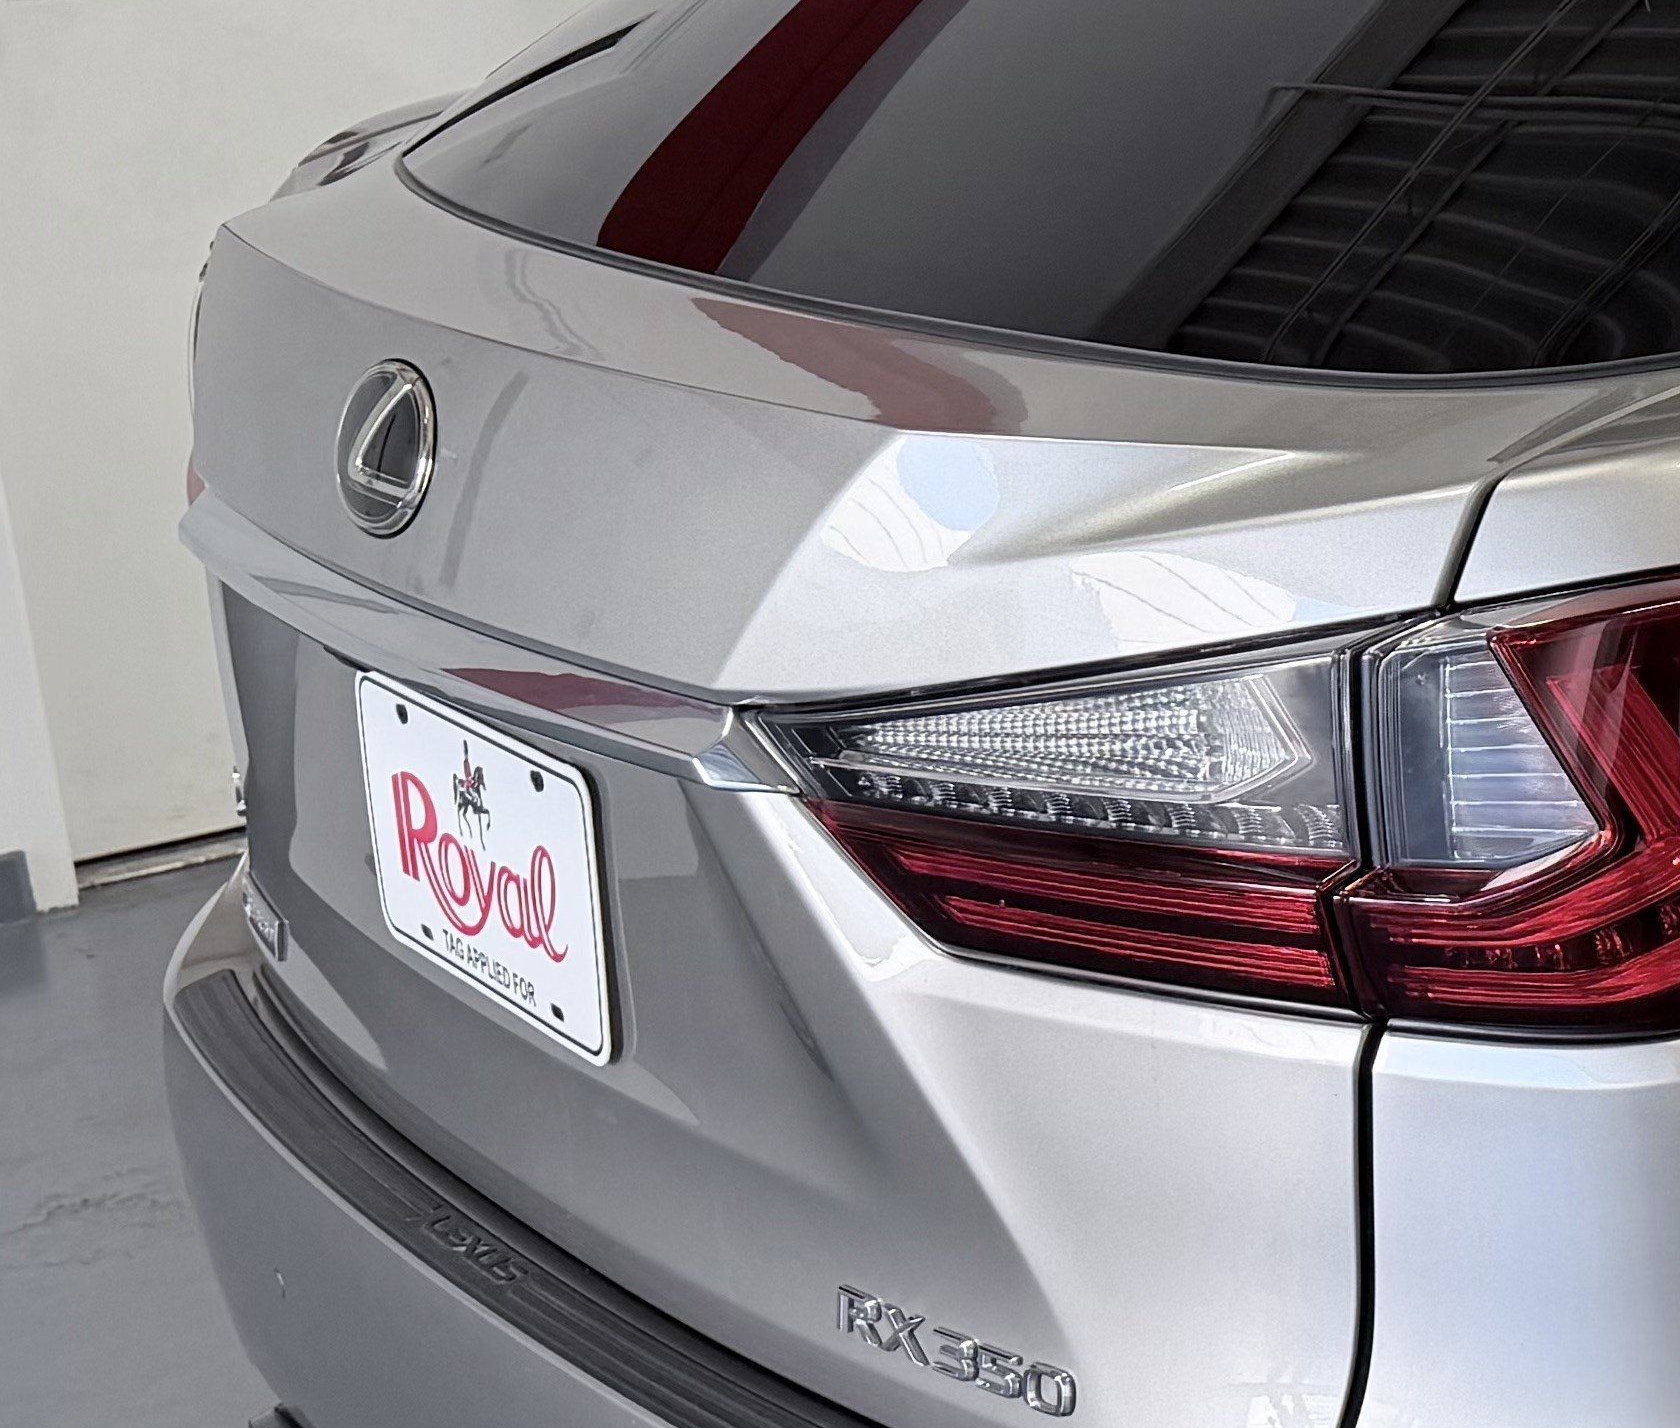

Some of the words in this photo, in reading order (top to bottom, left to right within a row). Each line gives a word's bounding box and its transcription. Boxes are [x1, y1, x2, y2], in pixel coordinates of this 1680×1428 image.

[391, 770, 569, 963] Royal
[442, 928, 465, 960] TAG
[466, 943, 511, 989] APPLIED
[512, 972, 537, 1007] FOR
